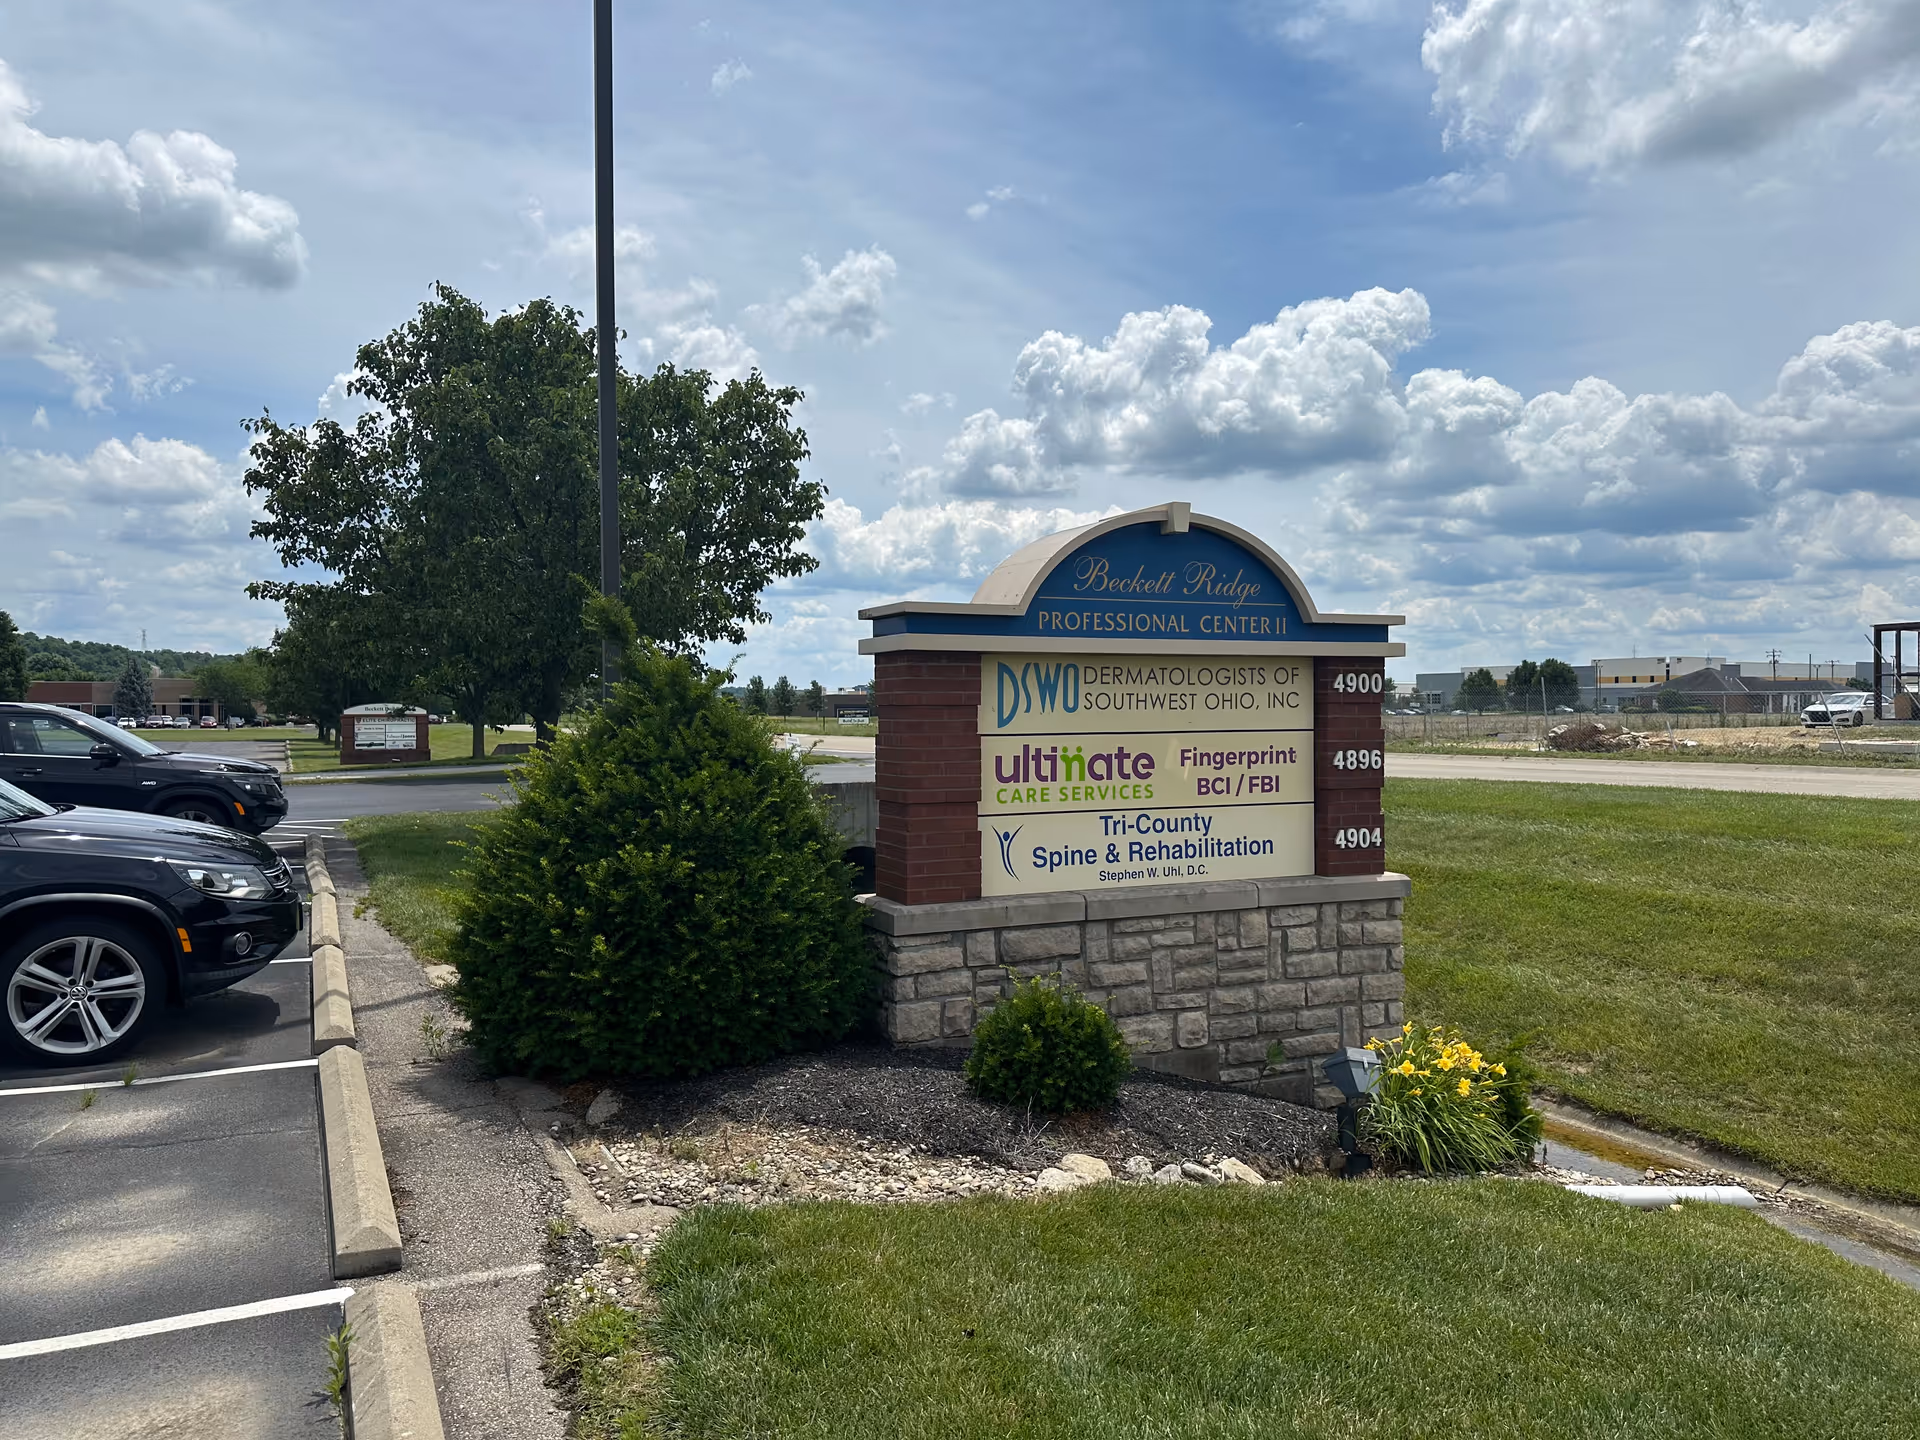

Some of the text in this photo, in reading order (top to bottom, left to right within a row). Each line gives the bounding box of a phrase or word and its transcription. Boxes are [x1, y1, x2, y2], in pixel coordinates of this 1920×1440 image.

[1073, 555, 1261, 609] Beckett Ridge
[1039, 611, 1189, 633] PROFESSIONAL
[1200, 615, 1271, 634] CENTER
[1083, 666, 1299, 685] DERMATOLOGISTS OF
[1333, 673, 1383, 694] 4900
[997, 661, 1079, 728] DSWO
[1083, 691, 1300, 711] SOUTHWEST OHIO, INC
[1180, 745, 1297, 771] Fingerprint
[1333, 750, 1382, 771] 4896
[996, 784, 1154, 804] CARE SERVICES
[1099, 812, 1213, 837] Tri-County
[1334, 827, 1382, 849] 4904
[1032, 836, 1274, 872] Spine & Rehabilitation
[1099, 864, 1208, 882] Stephen W. Uhl, D.C.
